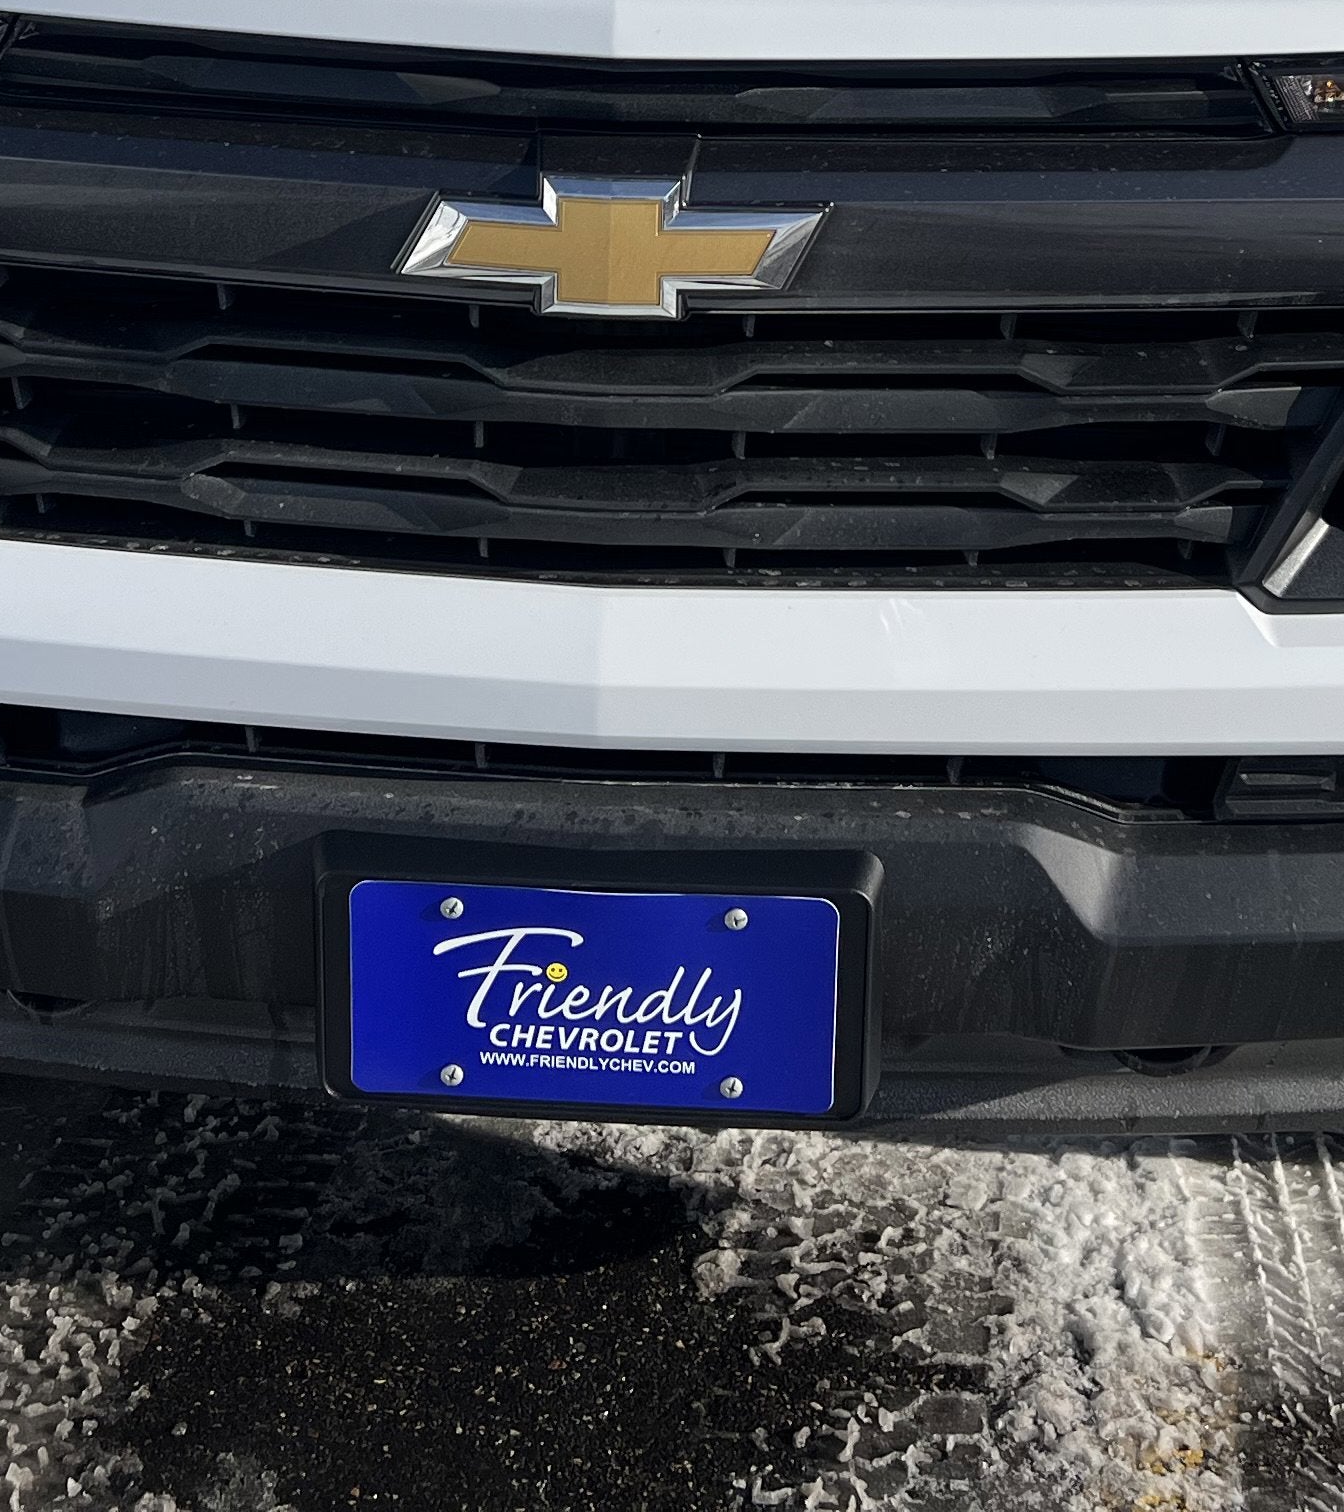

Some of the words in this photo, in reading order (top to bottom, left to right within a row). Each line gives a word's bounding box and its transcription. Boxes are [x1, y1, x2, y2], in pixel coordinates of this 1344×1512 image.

[432, 927, 742, 1056] Friendly
[489, 1022, 684, 1055] CHEVROLET
[479, 1050, 696, 1075] WWW.FRIENDLYCHEV.COM
